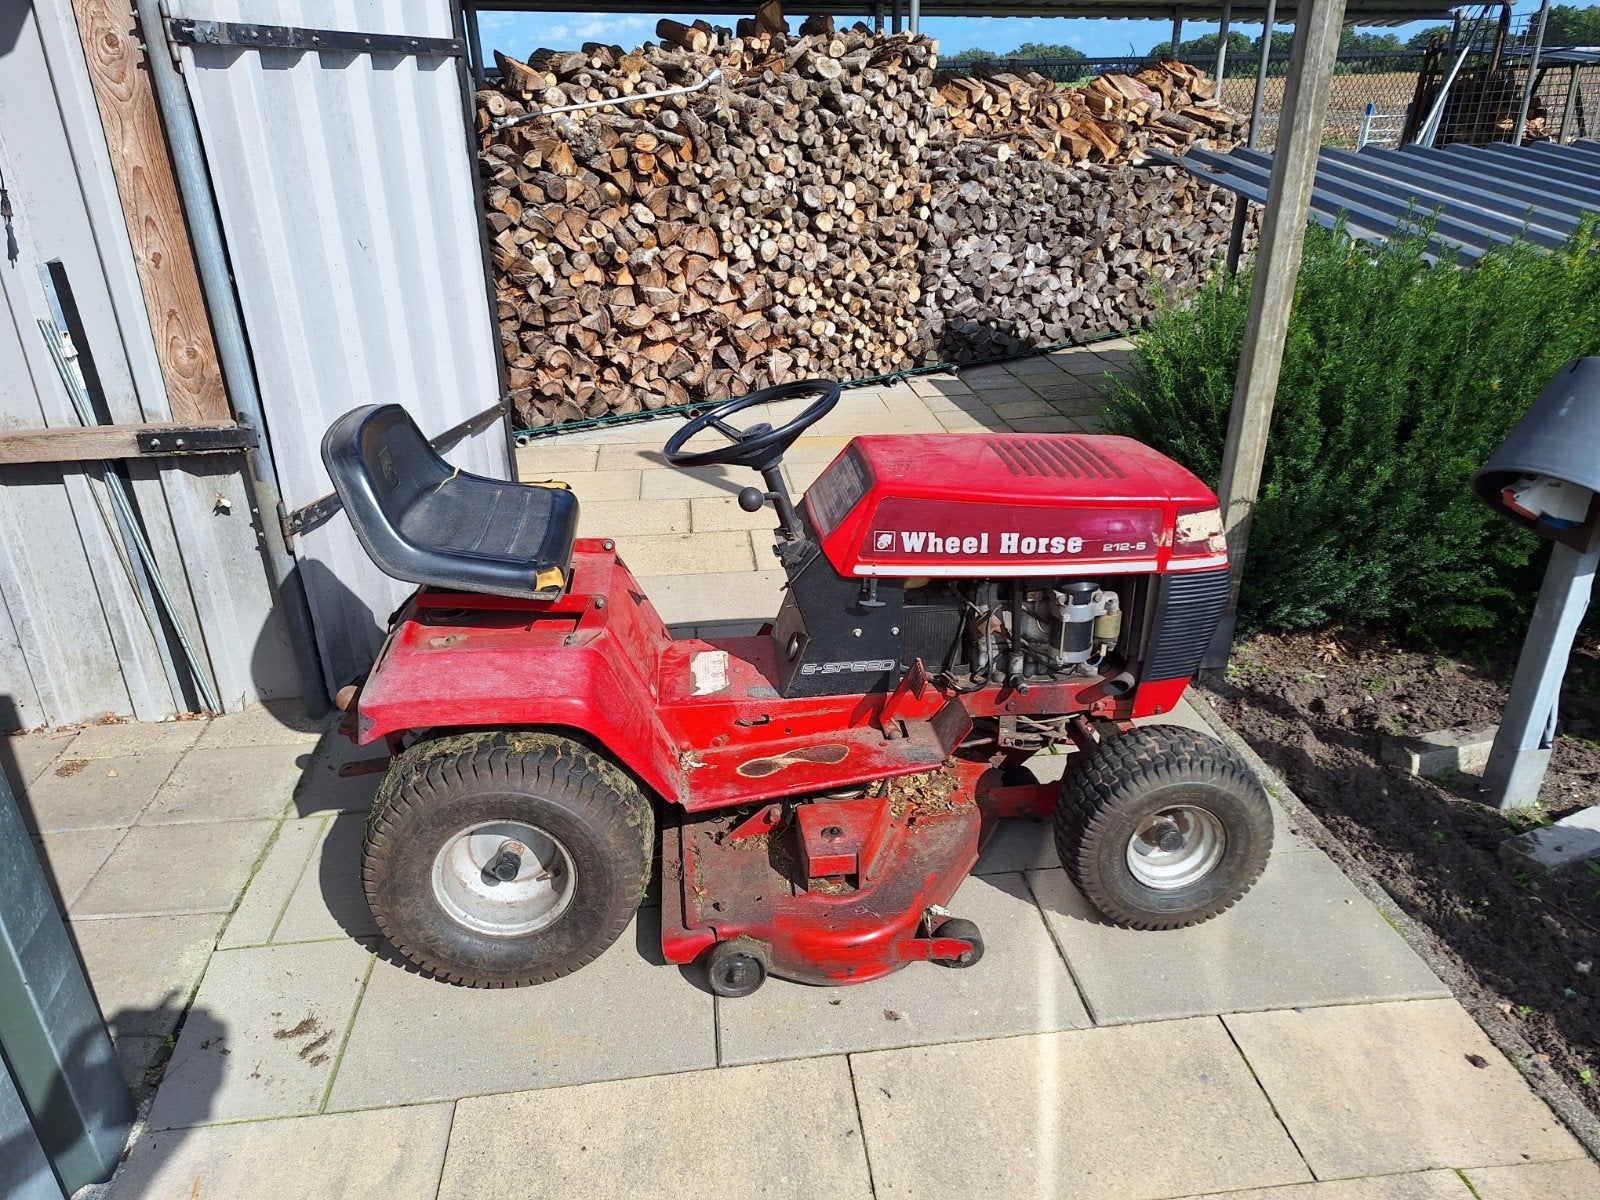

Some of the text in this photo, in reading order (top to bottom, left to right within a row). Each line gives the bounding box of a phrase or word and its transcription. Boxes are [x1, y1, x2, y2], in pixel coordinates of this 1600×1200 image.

[901, 531, 1083, 554] Wheel Horse
[1102, 541, 1147, 552] 212-6
